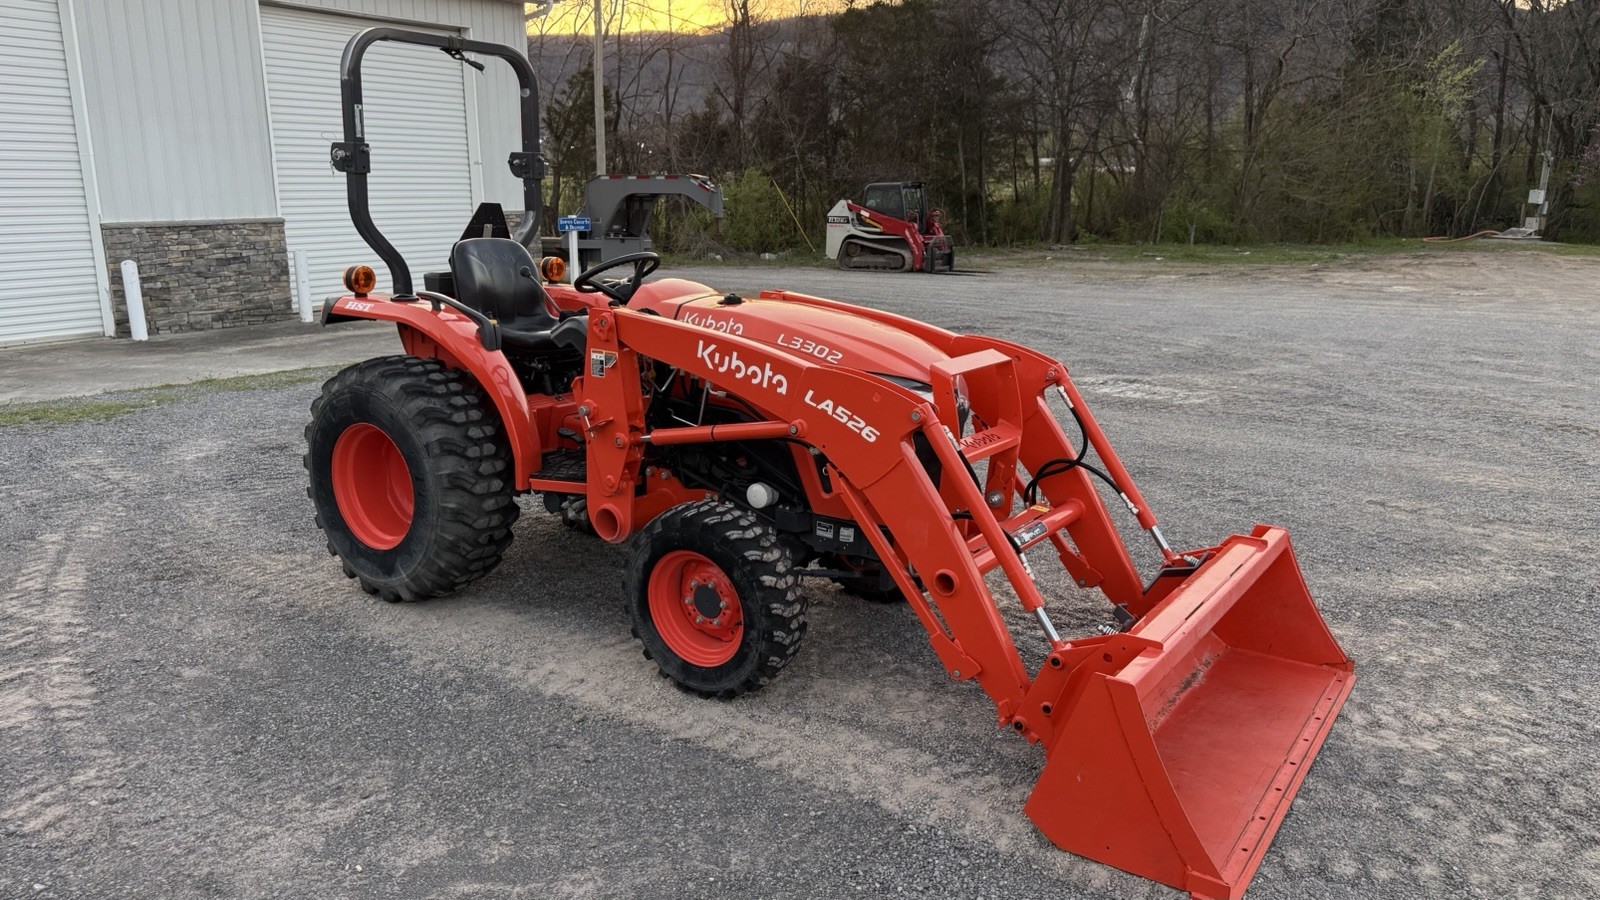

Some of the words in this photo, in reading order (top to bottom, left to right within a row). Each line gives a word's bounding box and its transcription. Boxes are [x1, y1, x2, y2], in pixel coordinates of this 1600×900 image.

[345, 301, 375, 312] HST
[684, 312, 744, 336] Kubota
[777, 333, 843, 365] L3302
[697, 340, 788, 396] Kubota
[804, 389, 881, 443] LA526
